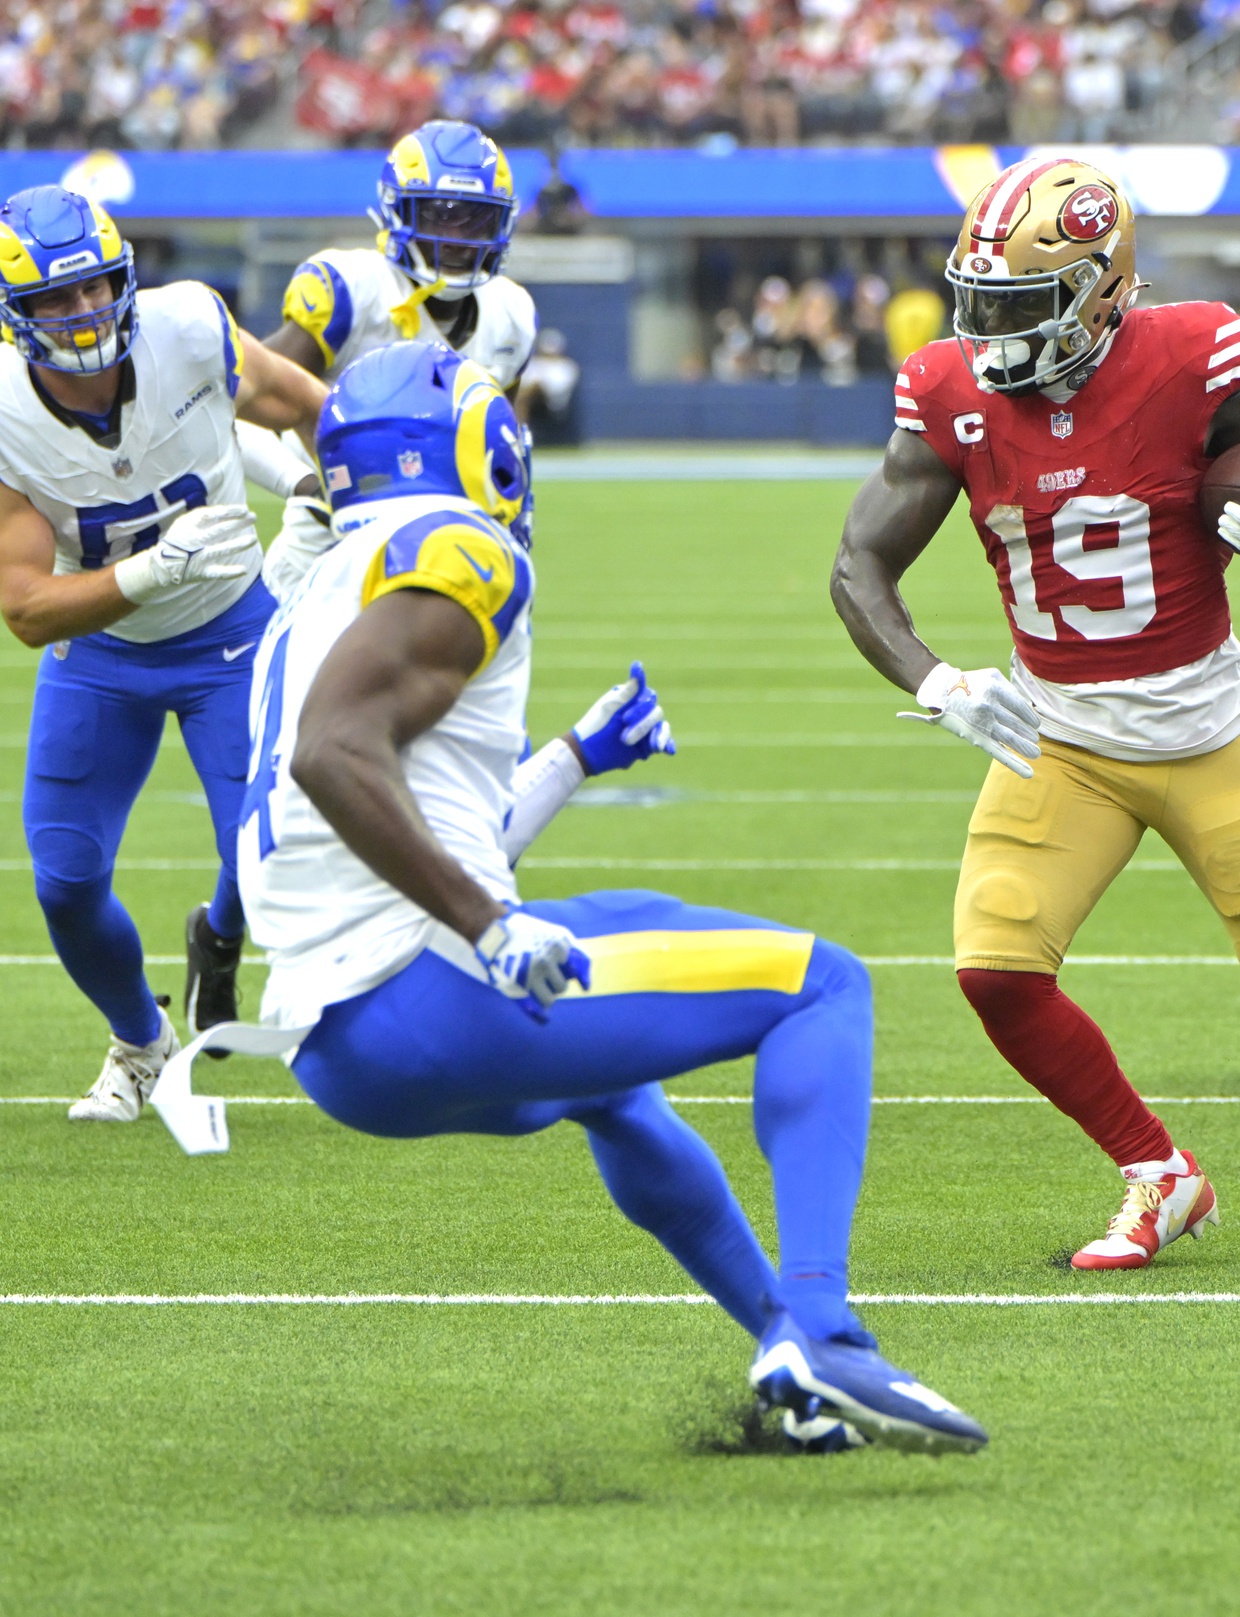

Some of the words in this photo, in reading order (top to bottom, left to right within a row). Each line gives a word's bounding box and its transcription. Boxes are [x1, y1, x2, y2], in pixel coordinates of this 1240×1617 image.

[174, 384, 213, 420] RAMS
[953, 412, 984, 444] C
[1055, 423, 1071, 434] NFL
[1036, 466, 1086, 493] 49ERS
[985, 493, 1157, 641] 19
